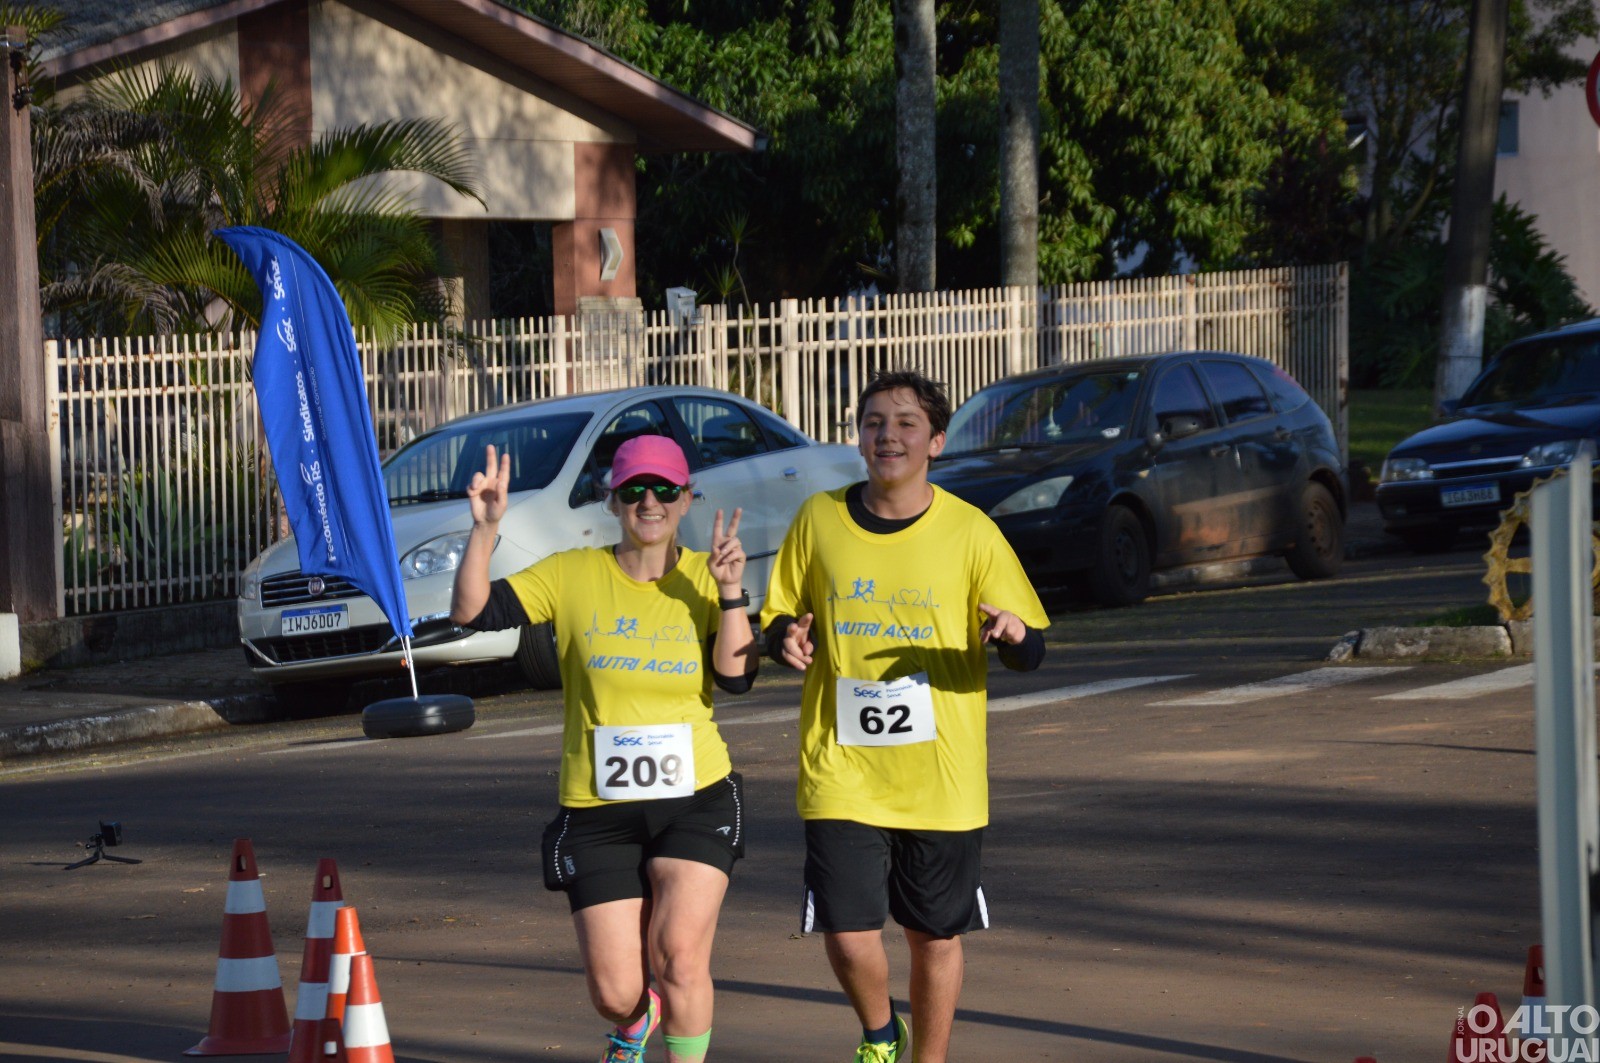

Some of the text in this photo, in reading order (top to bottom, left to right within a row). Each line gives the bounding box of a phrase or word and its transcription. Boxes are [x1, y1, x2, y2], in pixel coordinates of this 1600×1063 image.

[280, 316, 297, 353] Sesc
[295, 370, 315, 443] Sindicatos
[310, 460, 322, 482] RS
[316, 483, 337, 562] Fecomércio
[287, 612, 342, 632] IWJ6D07
[834, 621, 882, 637] NUTRI
[587, 654, 640, 671] NUTRI
[853, 686, 882, 699] Sesc
[860, 704, 913, 735] 62
[613, 735, 643, 746] Sesc
[605, 753, 684, 787] 209
